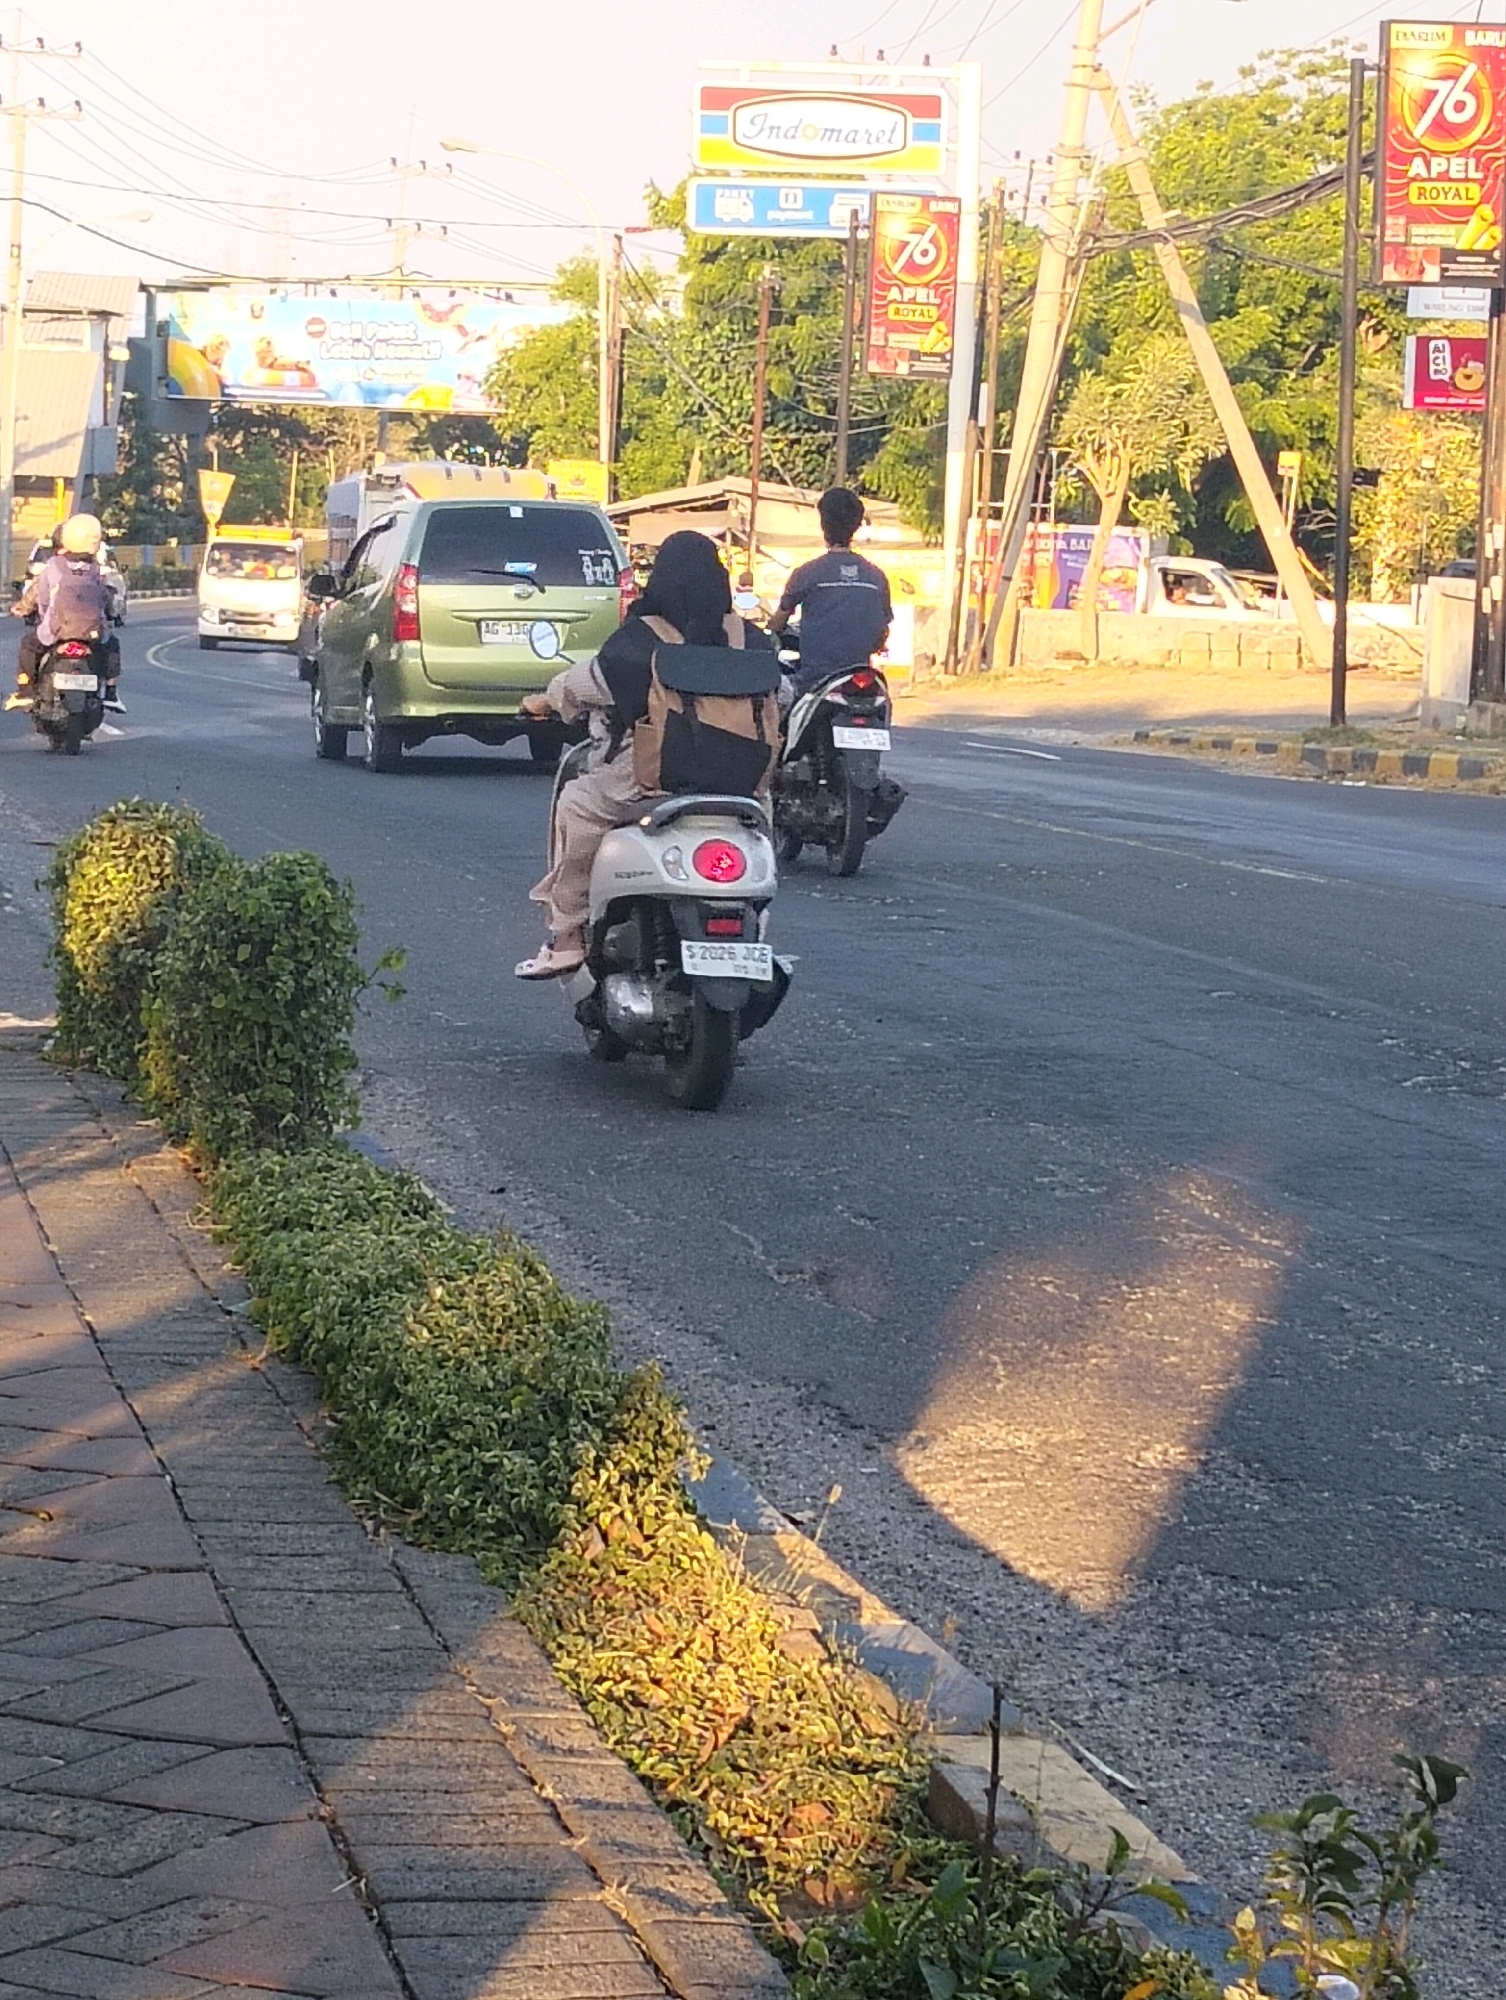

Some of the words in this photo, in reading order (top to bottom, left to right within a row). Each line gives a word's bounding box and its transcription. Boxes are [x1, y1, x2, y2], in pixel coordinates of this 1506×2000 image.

[1413, 62, 1478, 139] 76
[743, 112, 898, 145] Indomaret
[1407, 156, 1484, 179] APEL
[1417, 186, 1475, 201] ROYAL
[891, 223, 938, 275] 76
[886, 286, 940, 304] APEL
[893, 307, 933, 319] ROYAL
[484, 622, 499, 635] AG
[686, 944, 696, 960] S
[699, 945, 736, 961] 2026
